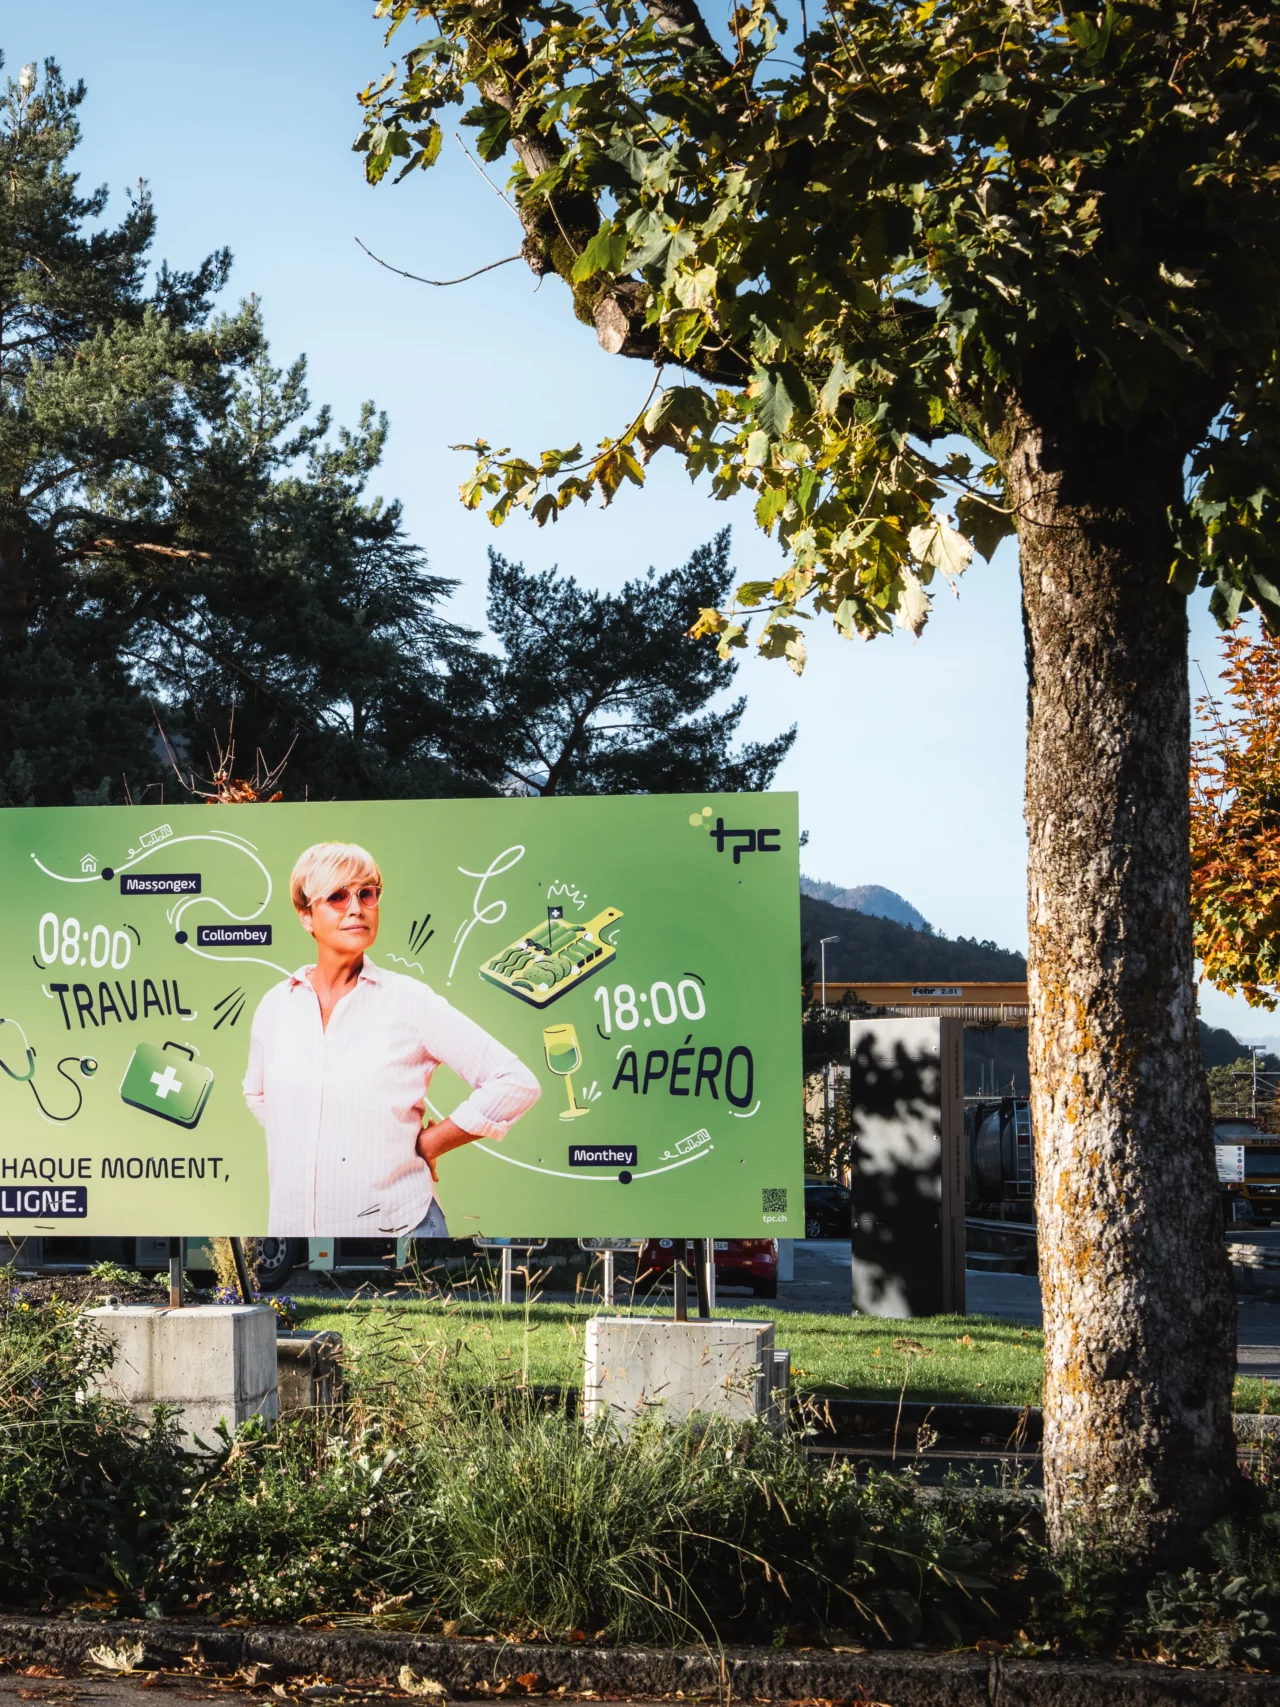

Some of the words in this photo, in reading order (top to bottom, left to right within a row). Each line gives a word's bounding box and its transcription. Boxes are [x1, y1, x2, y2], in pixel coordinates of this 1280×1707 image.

[710, 818, 781, 864] tpc
[126, 878, 196, 893] Massongex
[39, 912, 131, 969] 08:00
[202, 928, 267, 942] Collombey
[50, 979, 192, 1030] TRAVAIL
[594, 979, 706, 1032] 18:00
[612, 1034, 754, 1108] APÉRO
[574, 1149, 633, 1164] Monthey
[101, 1157, 230, 1182] MOMENT,
[1, 1190, 84, 1212] LIGNE.
[762, 1214, 787, 1223] tpc.ch
[661, 1239, 671, 1247] CH
